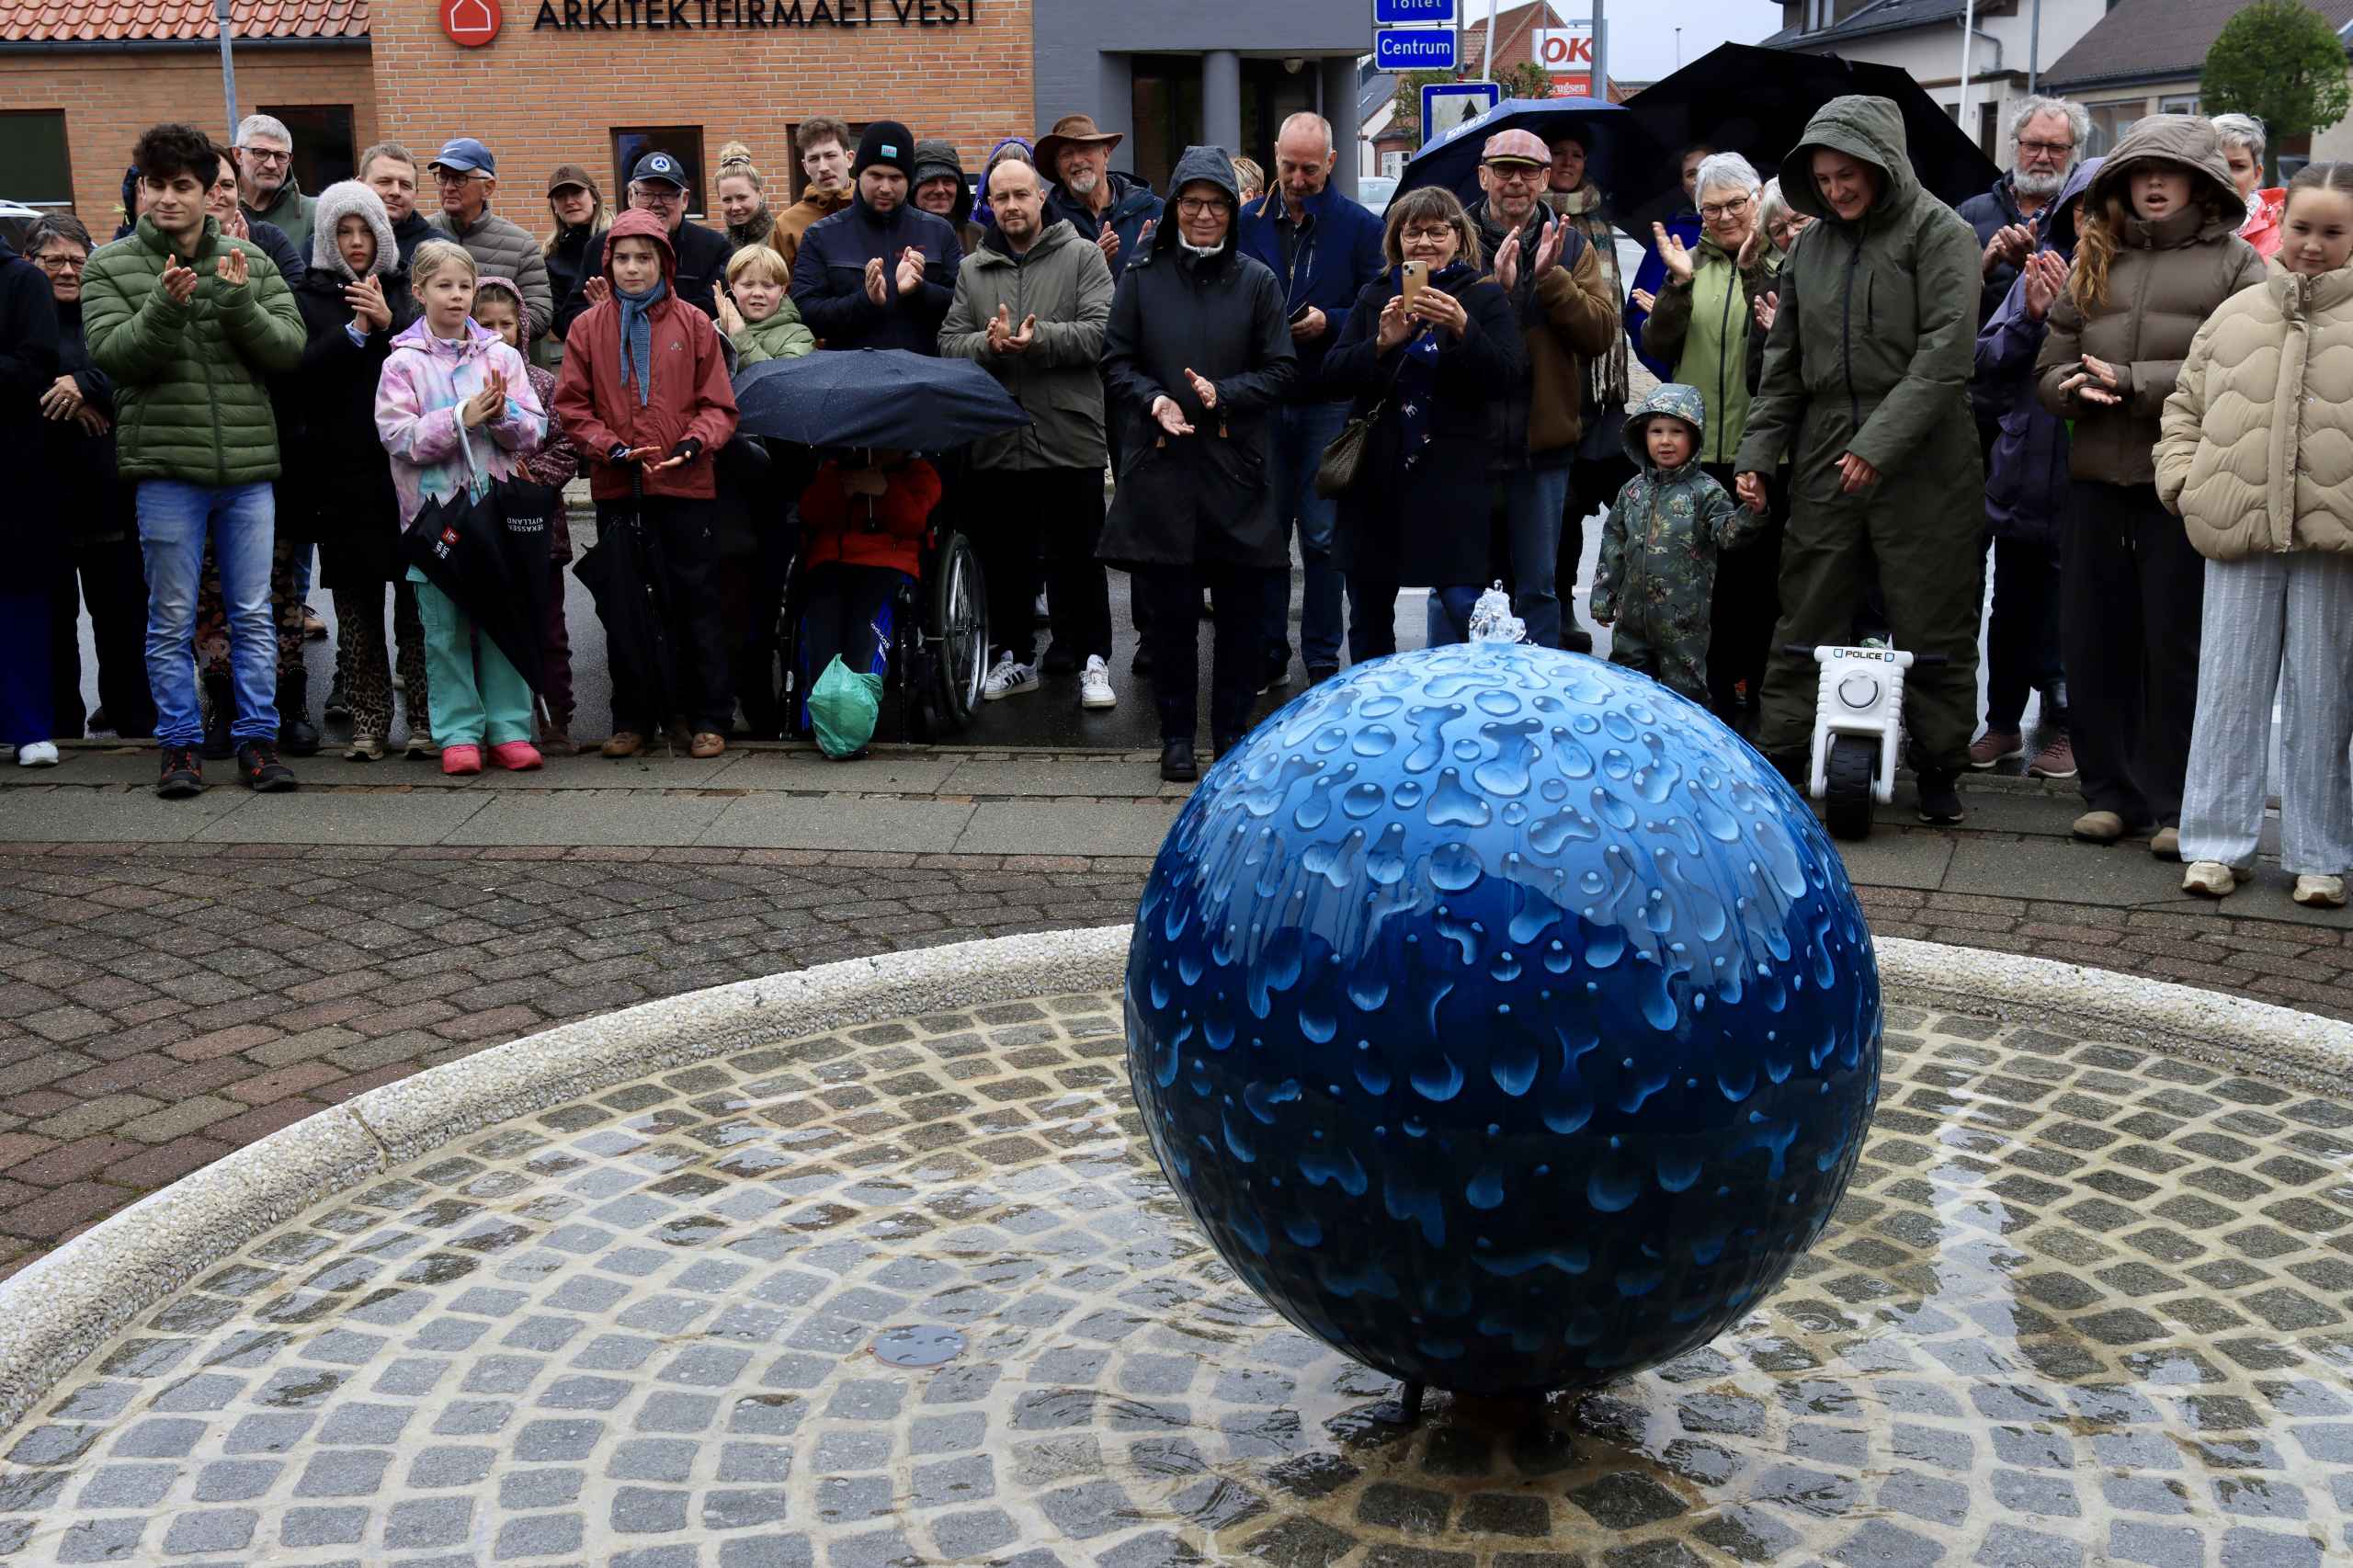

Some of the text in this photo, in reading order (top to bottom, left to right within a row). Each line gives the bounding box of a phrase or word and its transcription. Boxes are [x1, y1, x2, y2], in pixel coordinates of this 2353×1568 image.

[533, 0, 974, 29] ARKITEKTFIRMAET VEST
[1381, 39, 1450, 55] Centrum
[1540, 37, 1592, 62] OK
[870, 622, 891, 649] adidas
[1845, 651, 1882, 660] POLICE
